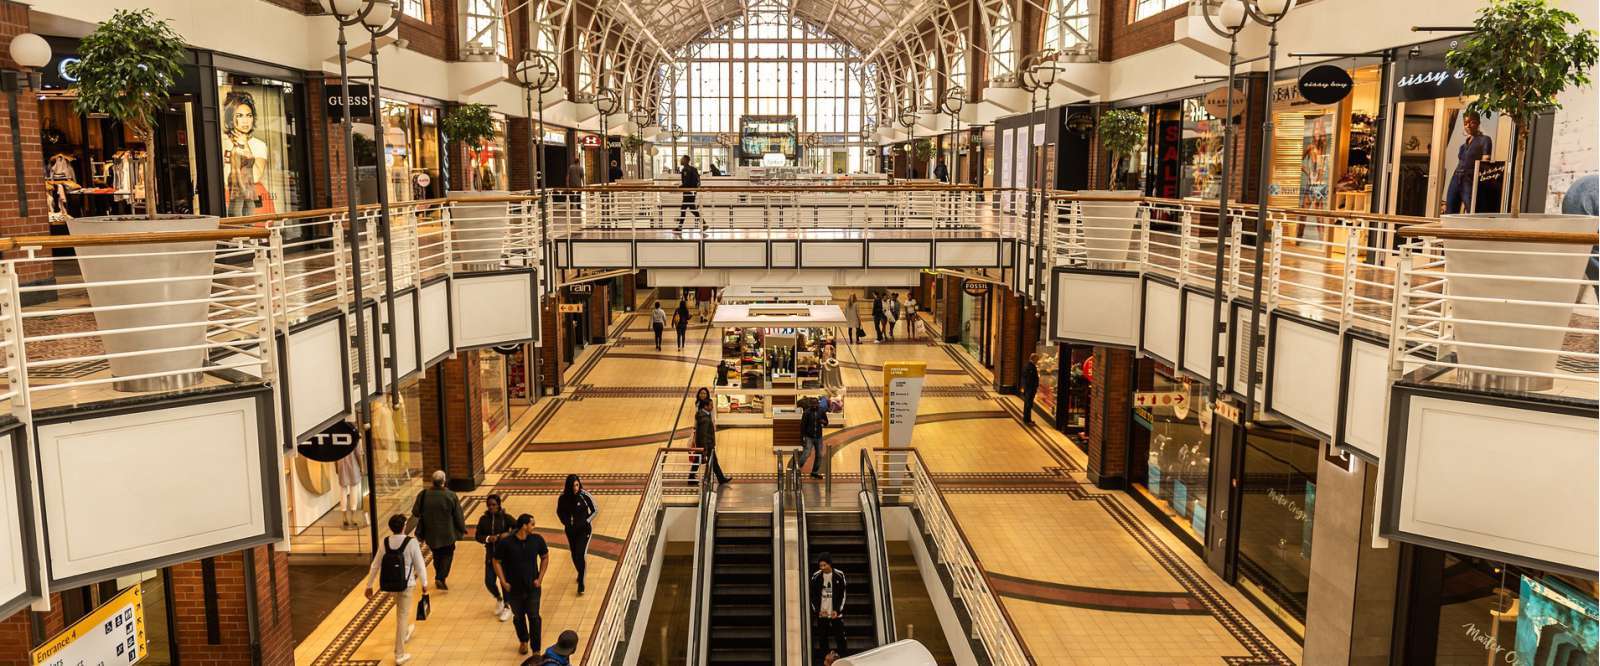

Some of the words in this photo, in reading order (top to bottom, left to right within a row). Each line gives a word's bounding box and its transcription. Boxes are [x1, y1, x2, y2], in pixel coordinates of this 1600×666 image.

[1304, 81, 1329, 89] sissy
[1397, 70, 1449, 87] sissy
[328, 96, 368, 106] GUESS
[1163, 126, 1179, 200] SALE
[569, 283, 592, 292] rain
[37, 638, 70, 662] Entrance
[71, 630, 77, 639] 4
